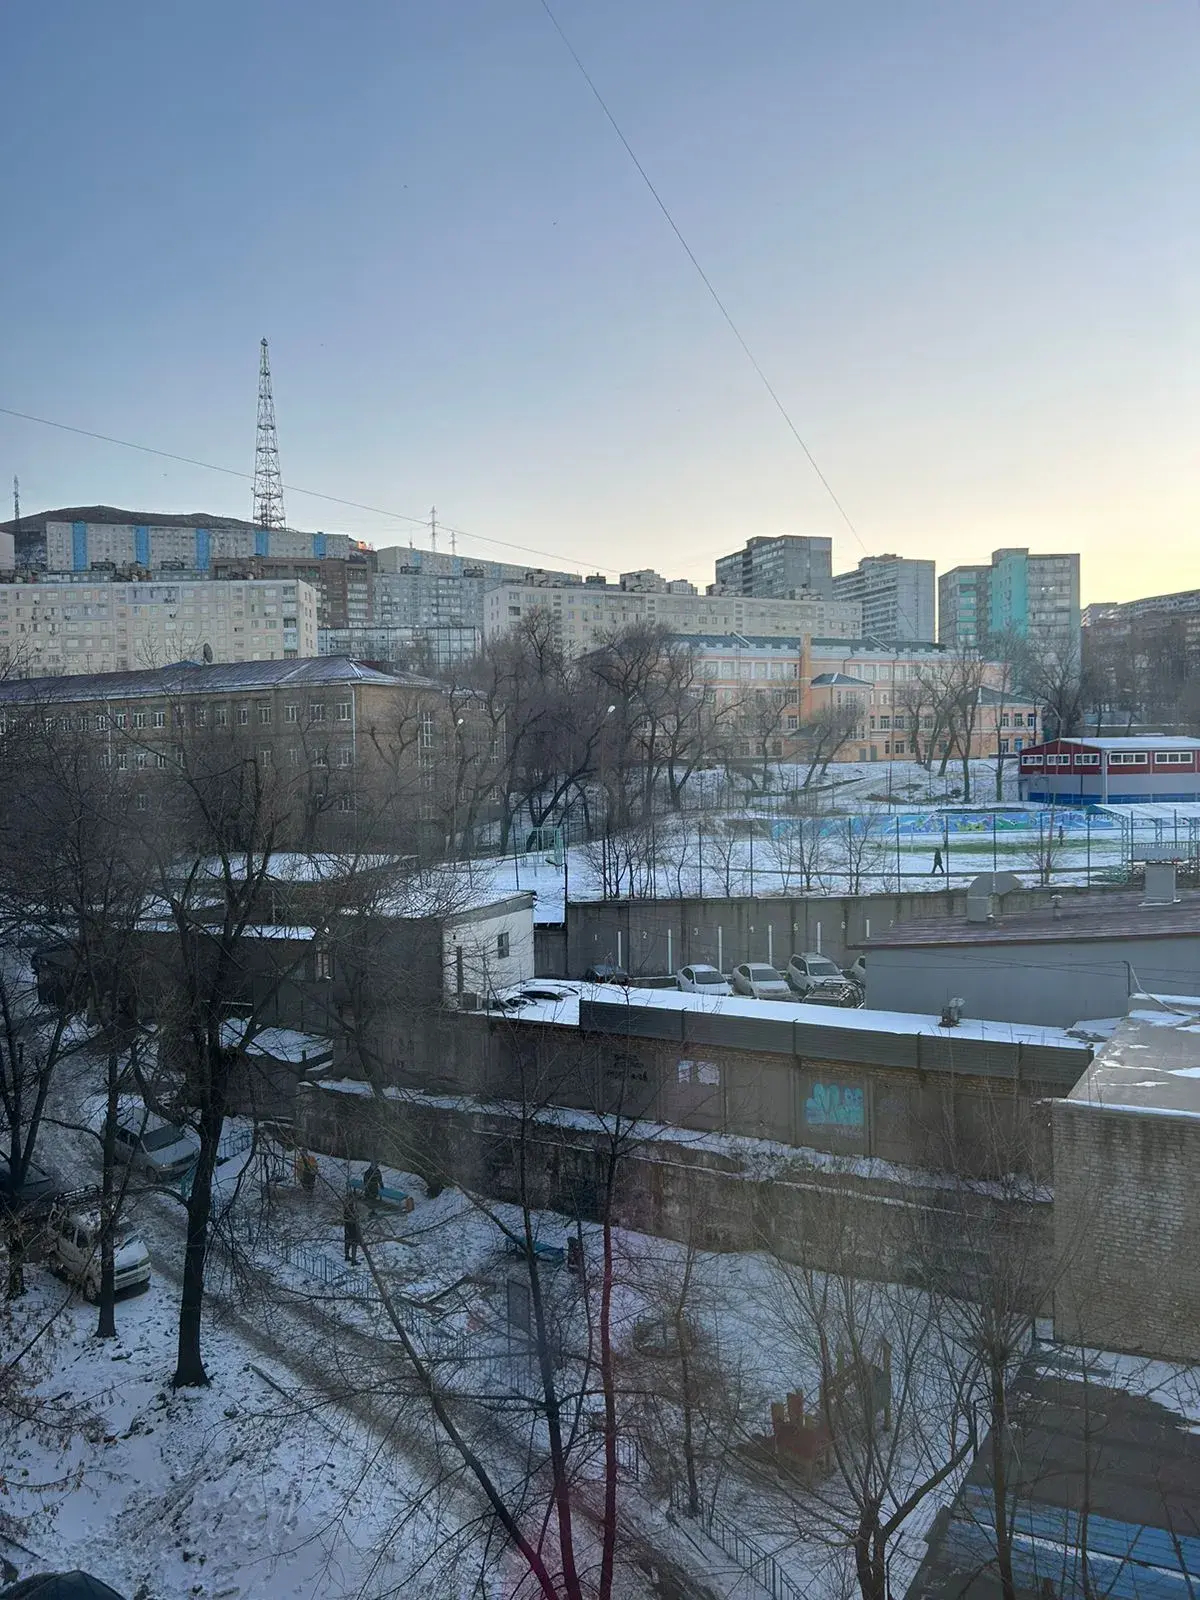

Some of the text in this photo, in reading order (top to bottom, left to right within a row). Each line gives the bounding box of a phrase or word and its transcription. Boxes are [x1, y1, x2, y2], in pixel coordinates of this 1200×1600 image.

[749, 925, 755, 934] 4
[793, 922, 799, 931] 5
[840, 921, 846, 930] 6
[642, 931, 648, 940] 2
[693, 927, 699, 936] 3
